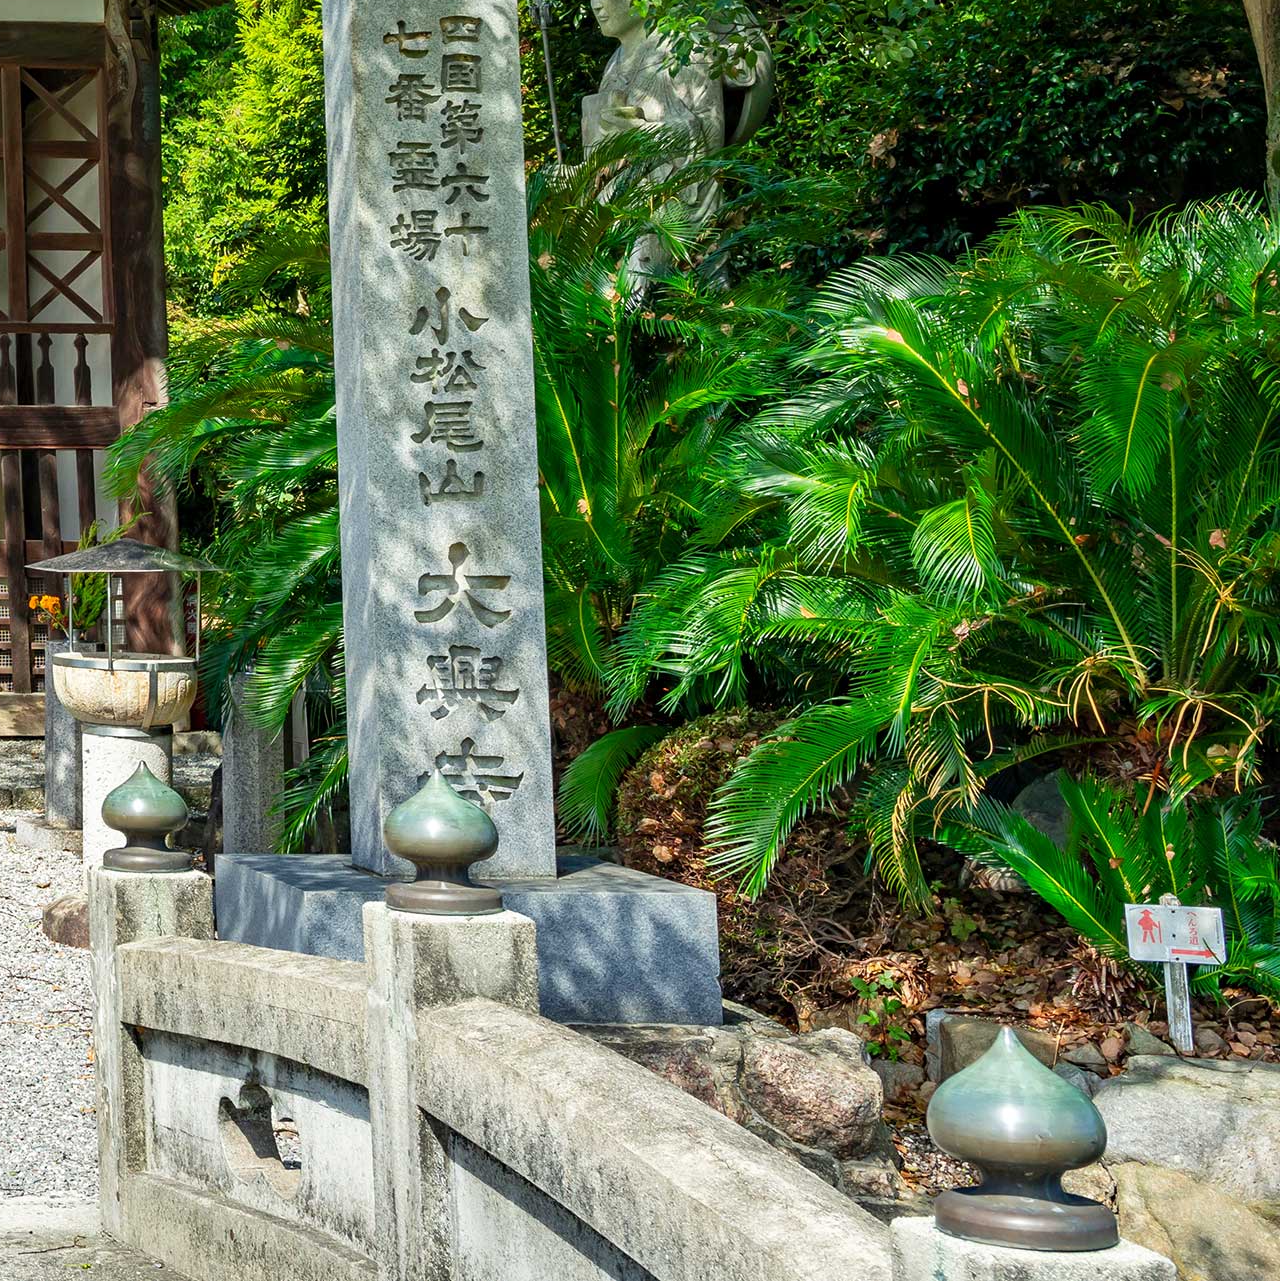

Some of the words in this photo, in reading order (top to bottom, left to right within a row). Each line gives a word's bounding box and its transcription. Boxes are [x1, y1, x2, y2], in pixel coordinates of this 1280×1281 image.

[439, 15, 490, 257] 四国第六十
[1187, 911, 1199, 946] へんろ道
